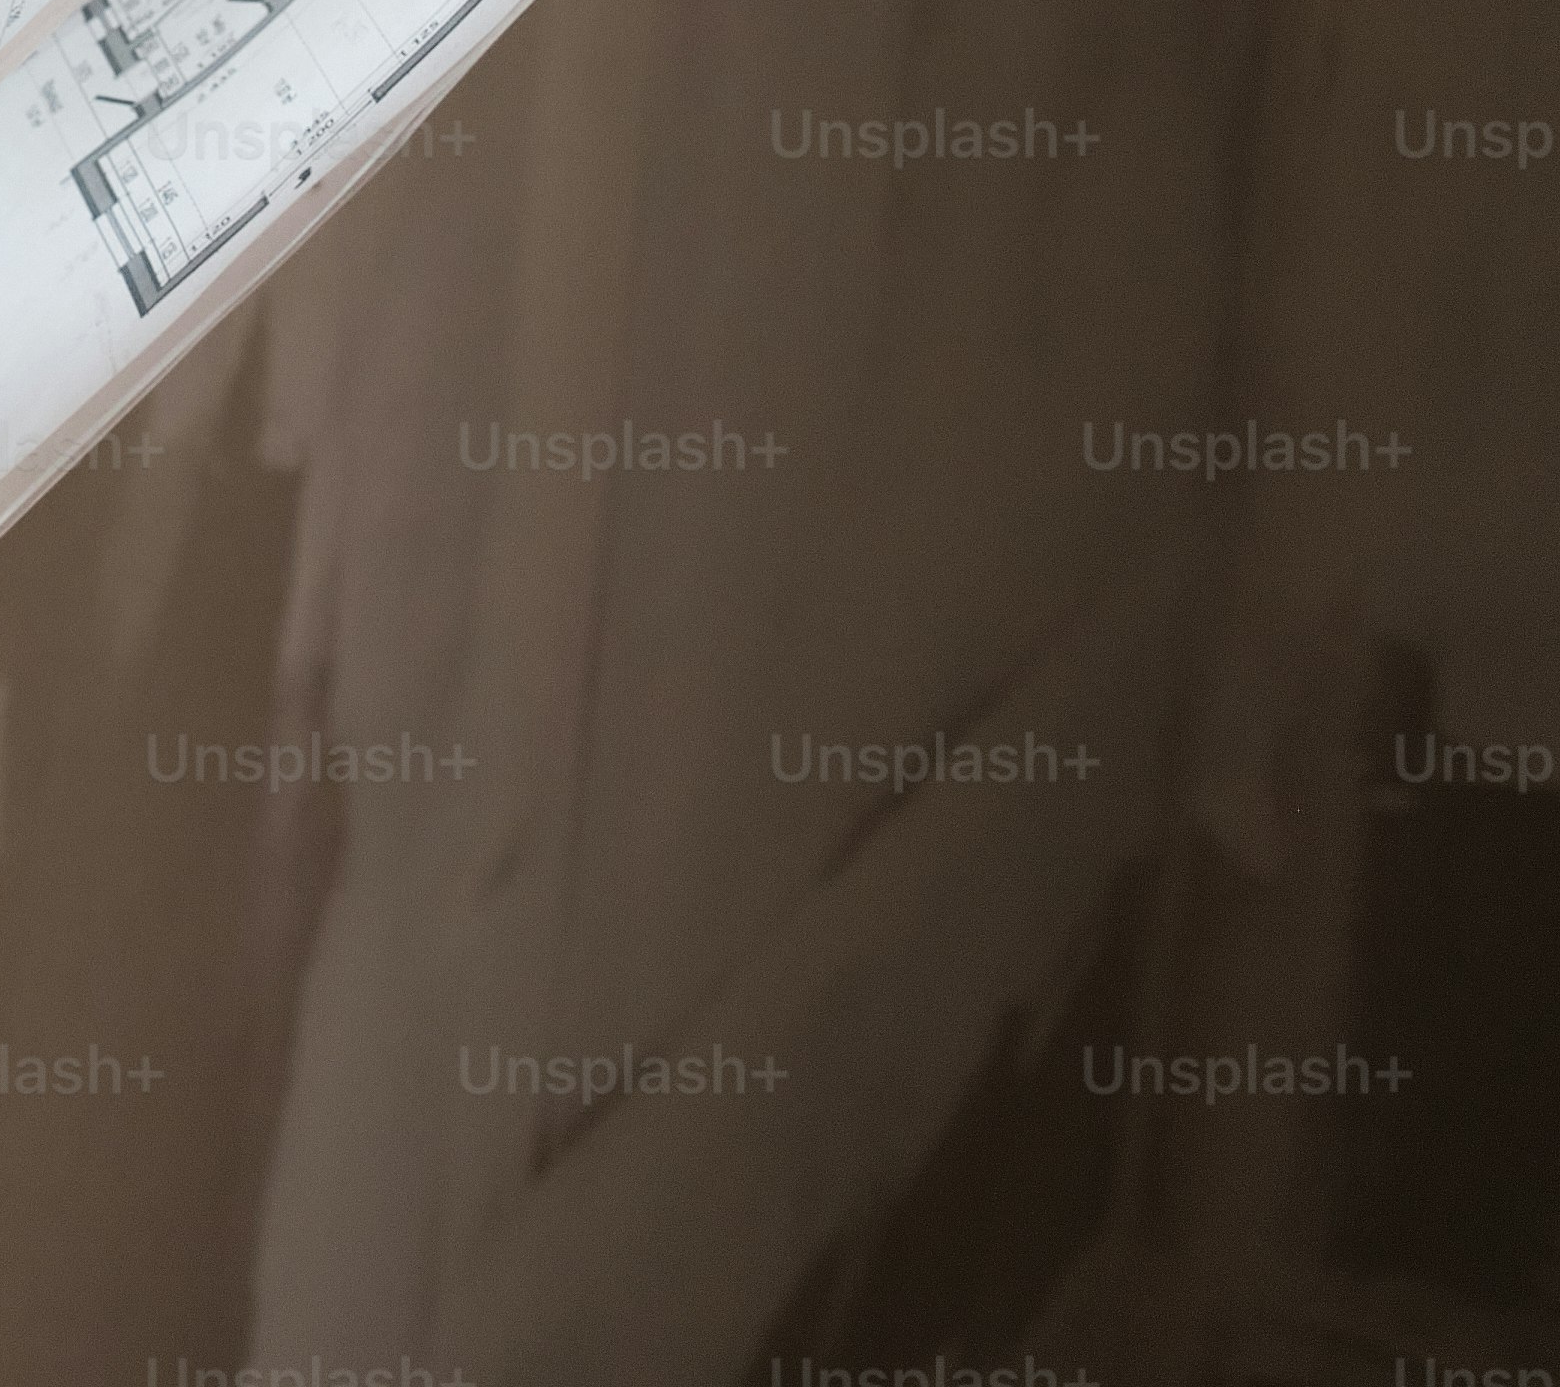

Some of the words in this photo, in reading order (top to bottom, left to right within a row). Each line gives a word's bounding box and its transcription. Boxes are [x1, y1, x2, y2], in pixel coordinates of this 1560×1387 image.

[411, 20, 439, 45] 125
[308, 117, 335, 147] 200
[204, 216, 232, 241] 120
